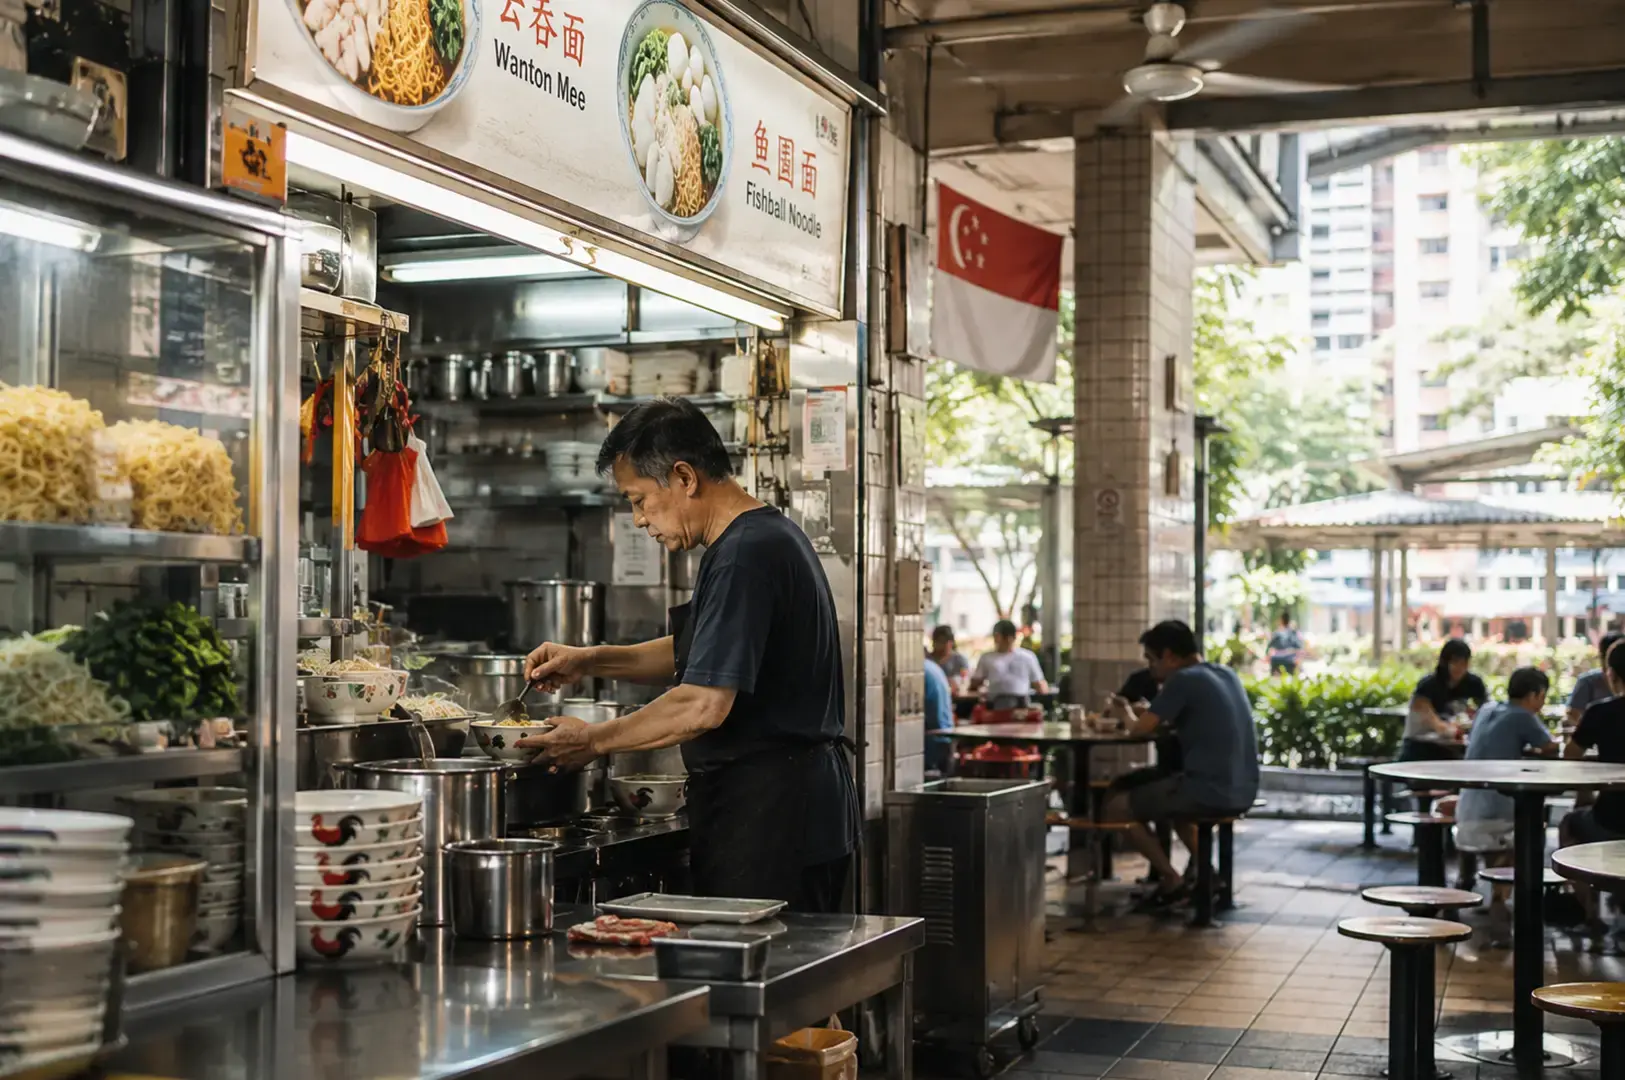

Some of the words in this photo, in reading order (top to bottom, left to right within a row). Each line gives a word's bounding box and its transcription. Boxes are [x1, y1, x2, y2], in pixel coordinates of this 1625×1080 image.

[494, 38, 553, 94] Wanton
[557, 72, 586, 111] Mee
[746, 180, 786, 222] Fishball
[788, 202, 822, 239] Noodle
